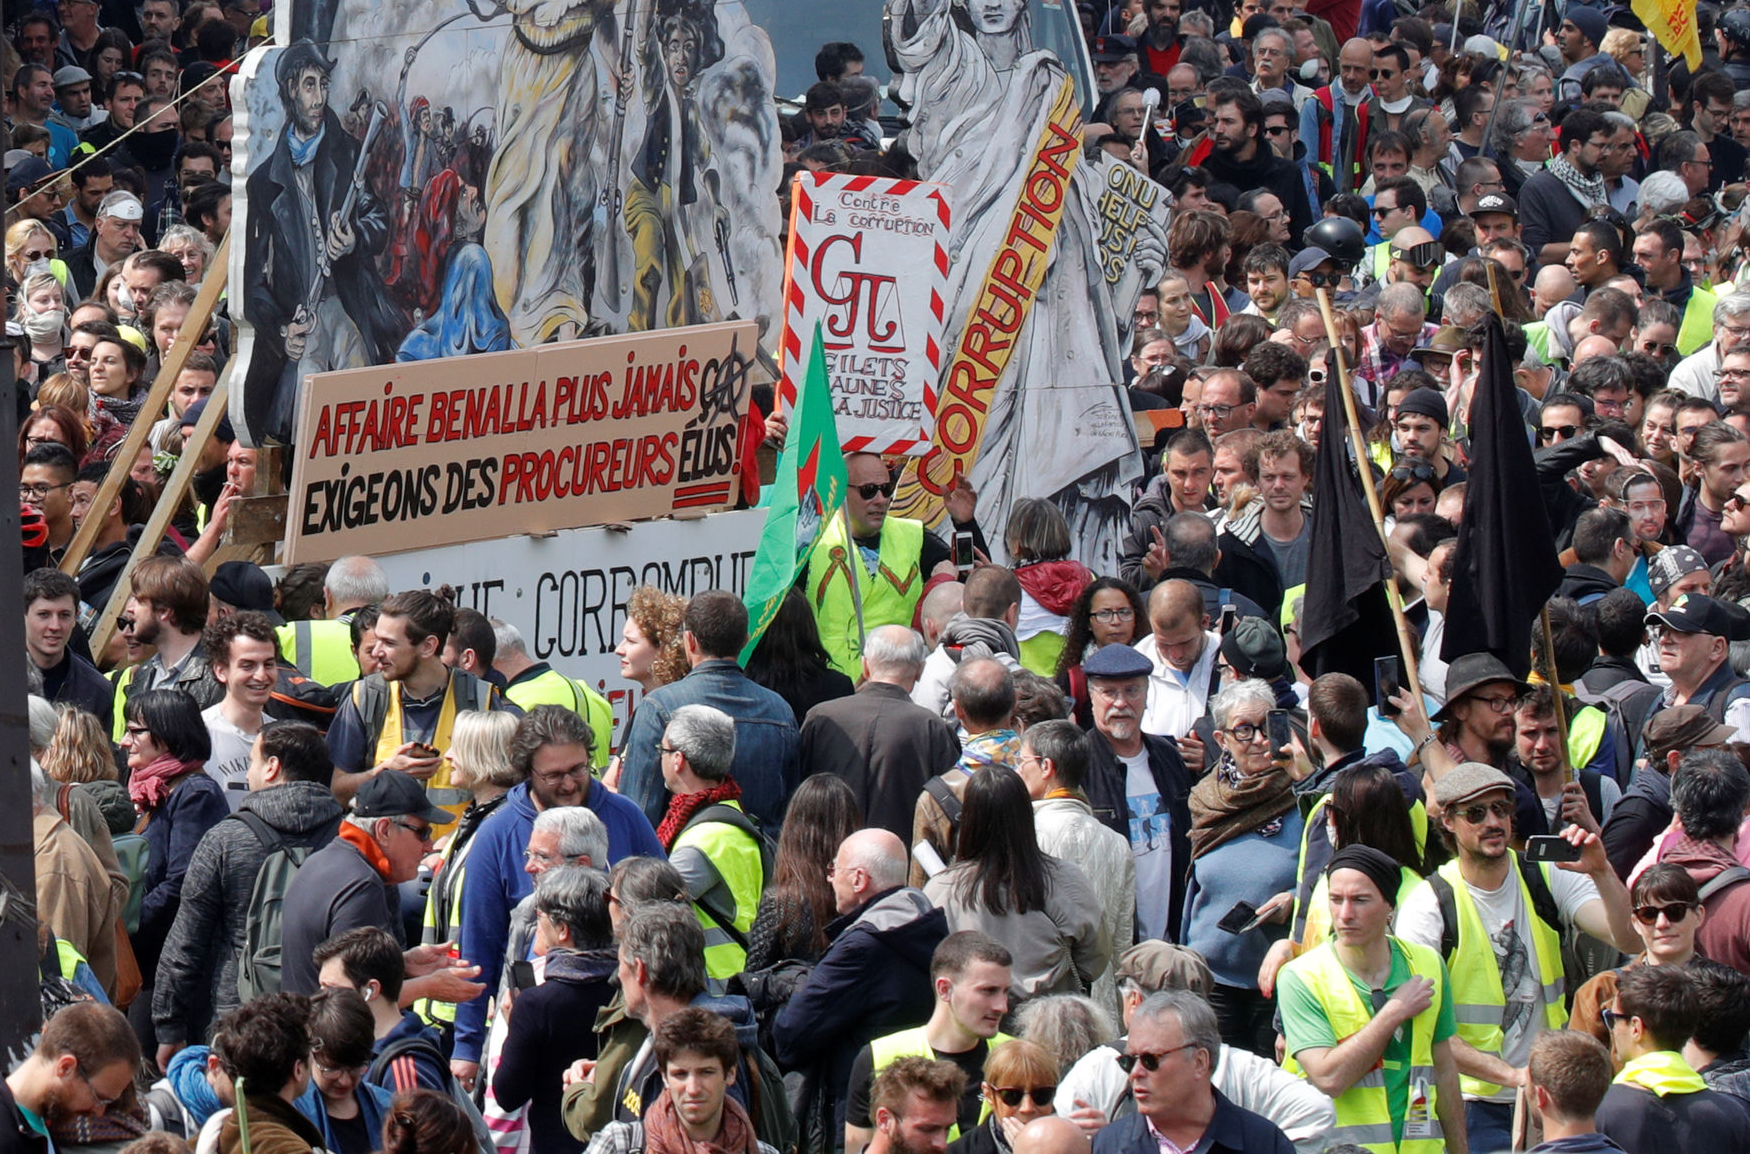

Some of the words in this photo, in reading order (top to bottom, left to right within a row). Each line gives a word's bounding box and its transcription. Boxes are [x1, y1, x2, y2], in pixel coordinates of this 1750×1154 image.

[838, 191, 902, 214] Contre
[1107, 164, 1159, 210] ONU
[813, 203, 836, 224] La
[917, 123, 1080, 497] CORRUPTION
[309, 381, 425, 461] AFFAIRE
[425, 379, 547, 445] BENALLA
[551, 370, 612, 430] PLUS
[611, 344, 700, 421] JAMAIS
[832, 376, 908, 400] AUNES
[852, 397, 923, 421] JUSTICE
[301, 462, 441, 537] EXIGEONS
[442, 456, 499, 514] DES
[497, 431, 679, 506] PROCUREURS
